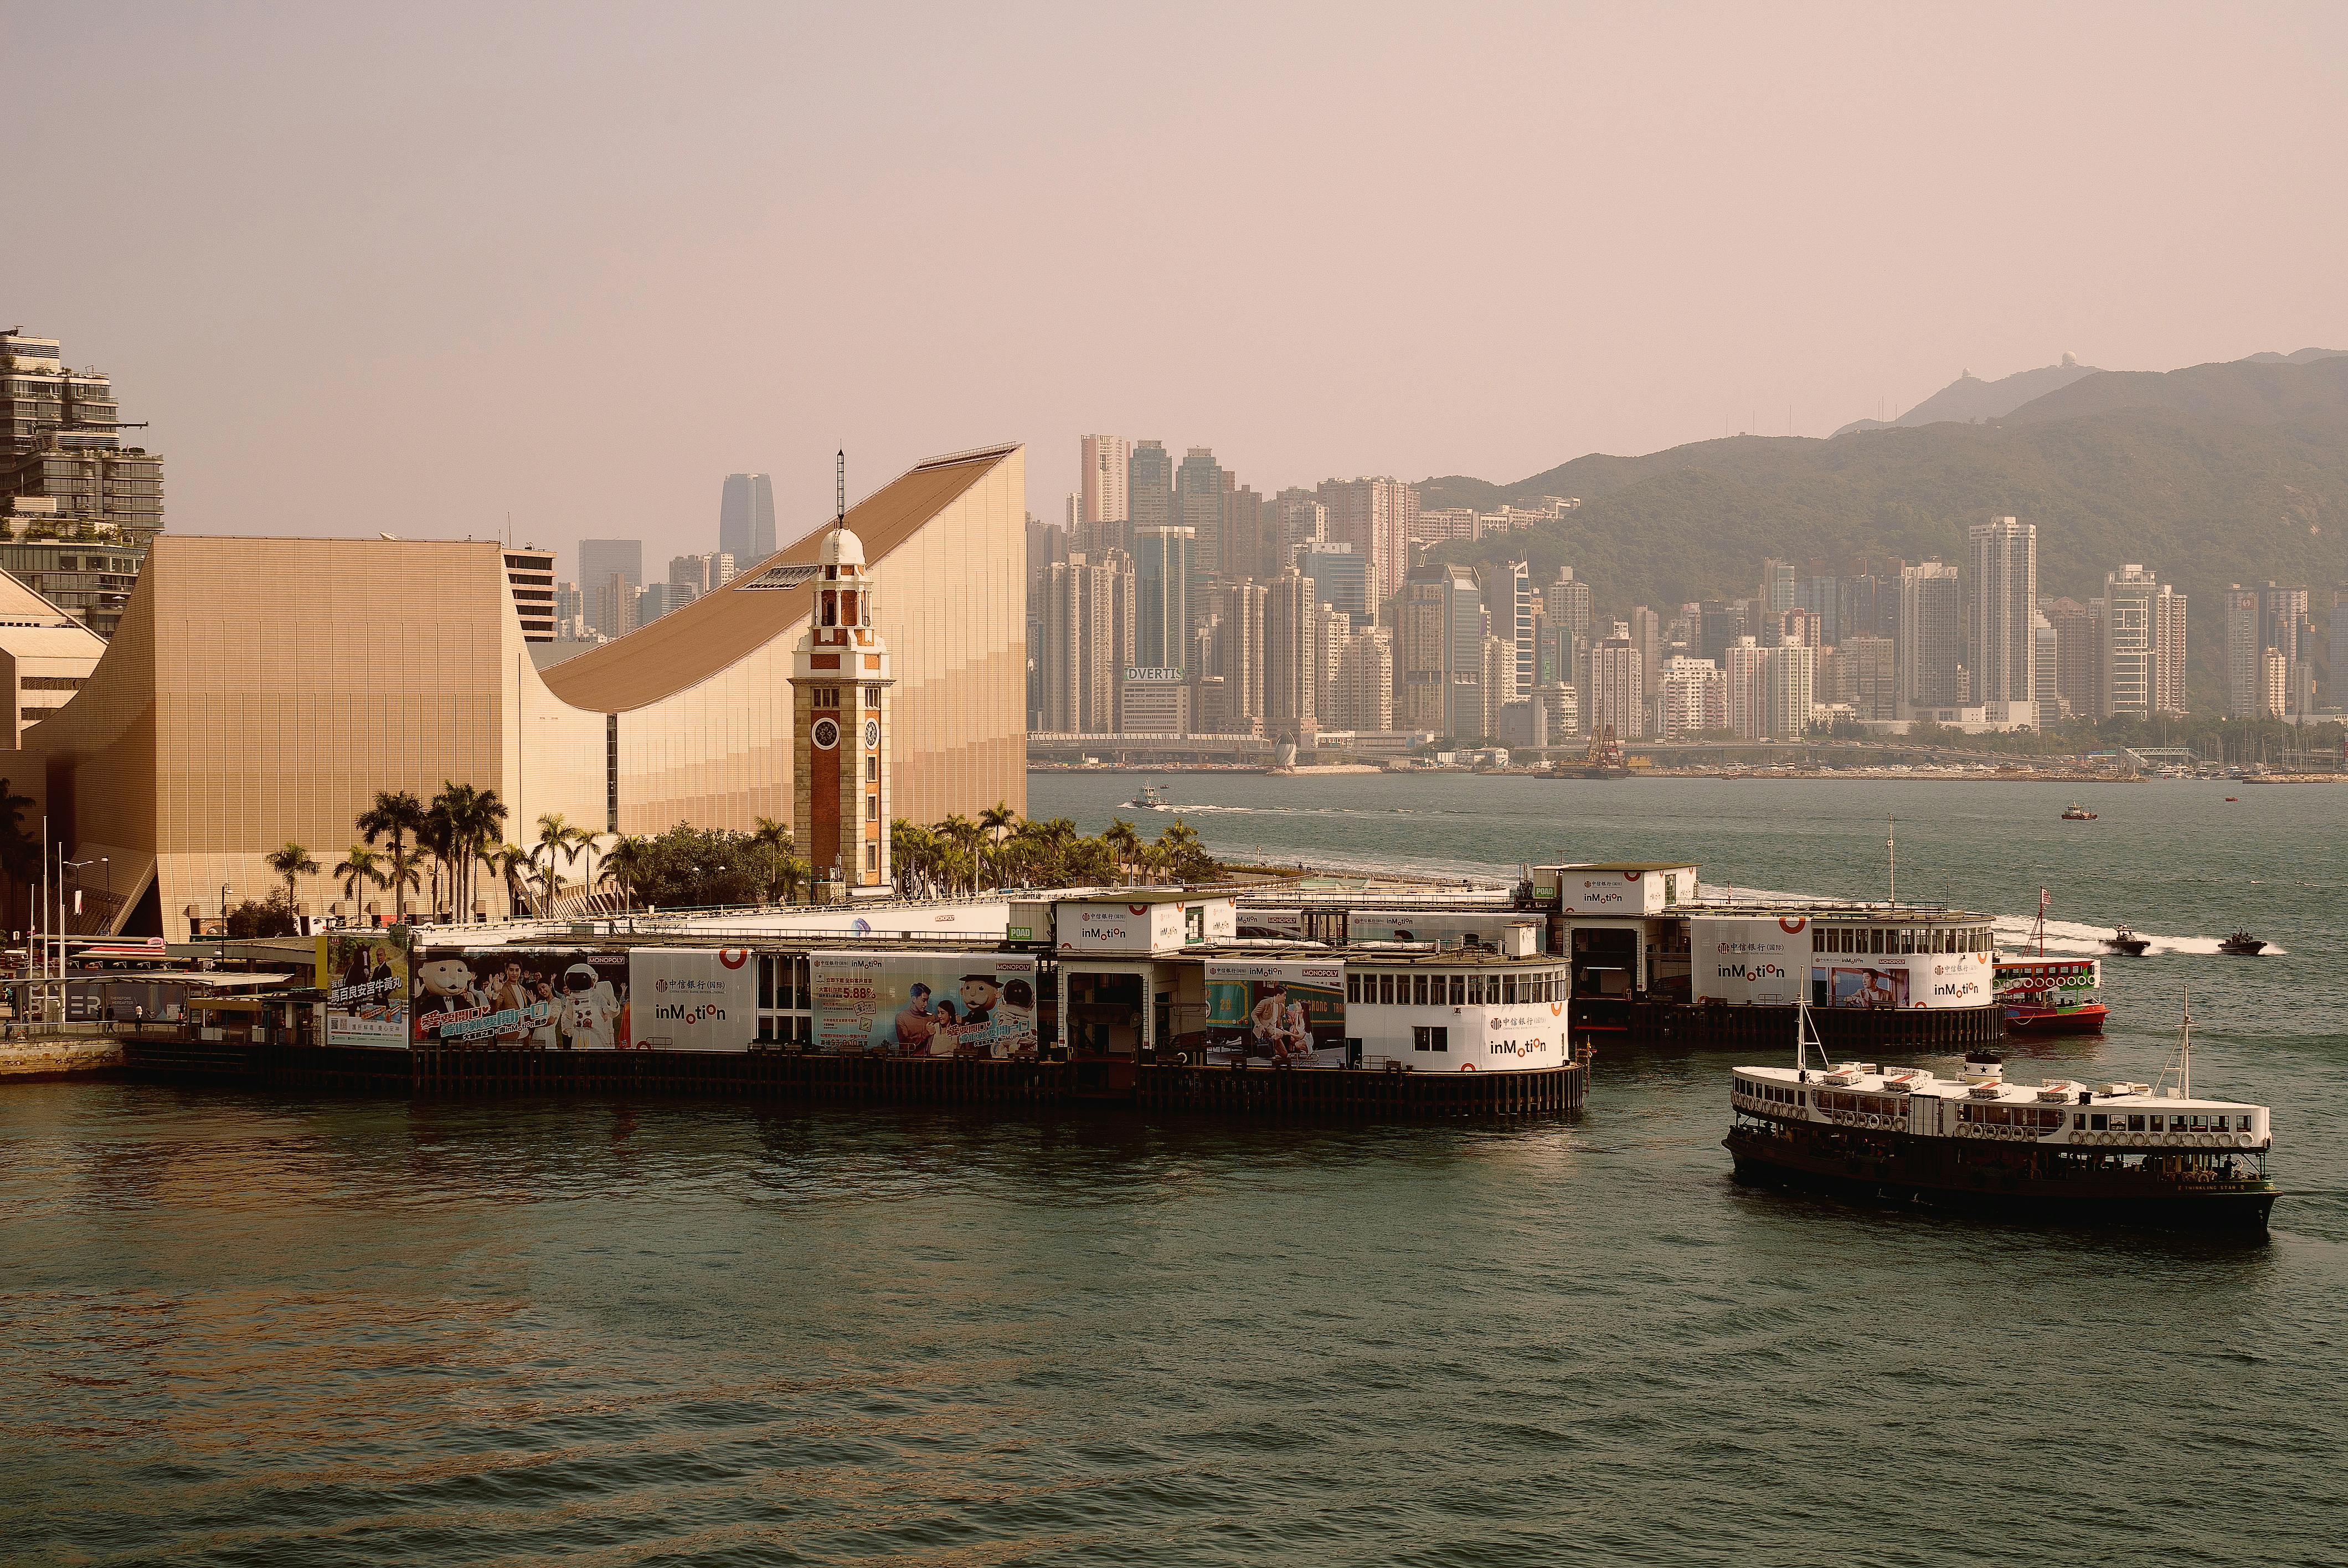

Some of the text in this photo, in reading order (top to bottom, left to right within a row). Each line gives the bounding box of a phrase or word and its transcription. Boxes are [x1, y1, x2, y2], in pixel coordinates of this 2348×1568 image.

[1584, 893, 1622, 904] inMotion
[1011, 929, 1031, 937] POAD
[1082, 928, 1126, 941] inMotion
[1731, 942, 1784, 952] 中信银行(国际)
[851, 960, 882, 969] inMotion
[1249, 967, 1283, 977] inMotion
[1718, 963, 1785, 982] inMotion
[669, 979, 726, 990] 中信银行(国际)
[1934, 982, 1979, 998] inMotion
[843, 987, 877, 999] 5.88%
[656, 1004, 726, 1025] inMotion
[1490, 1038, 1546, 1058] inMotion
